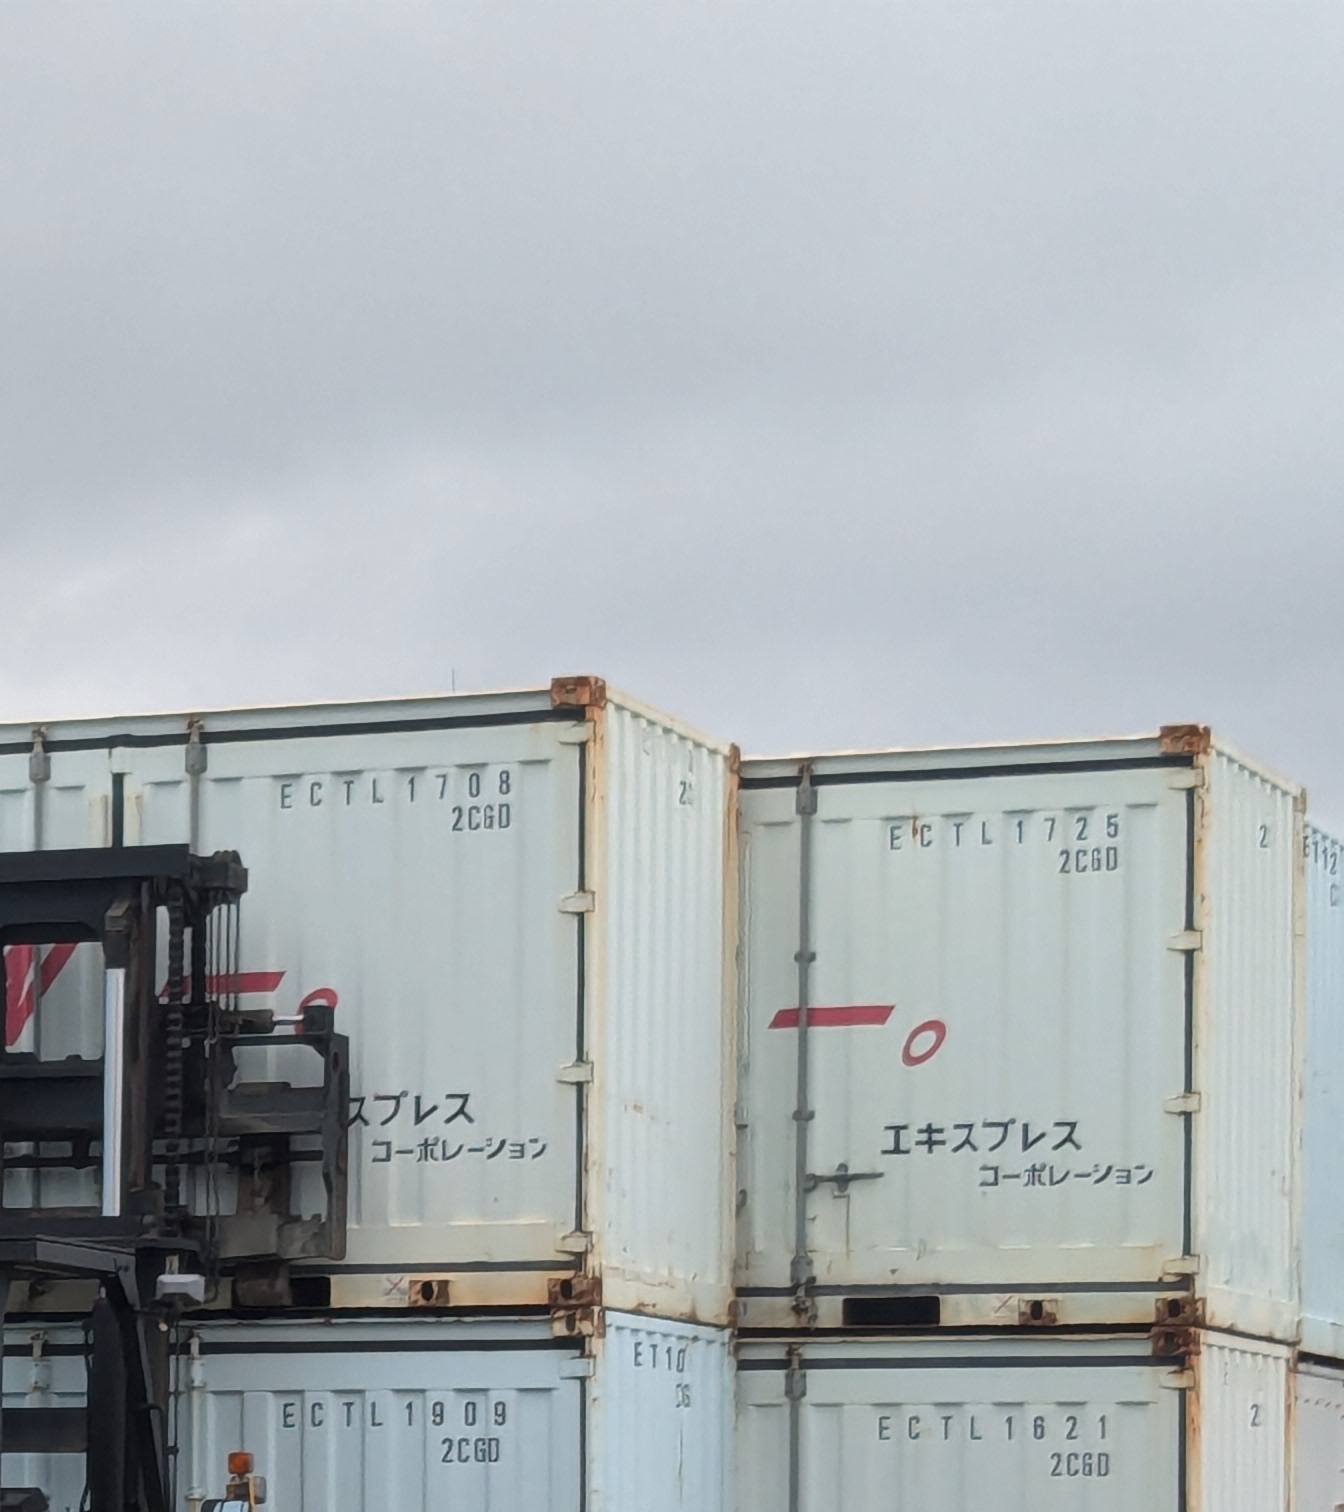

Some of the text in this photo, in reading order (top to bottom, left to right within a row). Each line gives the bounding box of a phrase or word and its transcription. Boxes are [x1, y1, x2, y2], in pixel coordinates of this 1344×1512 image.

[280, 769, 511, 809] ECTL1708
[889, 813, 1119, 850] ECTL1725
[348, 1089, 475, 1127] スプレス
[371, 1136, 548, 1163] コーポレーション
[880, 1118, 1082, 1155] エキスプレス
[979, 1163, 1154, 1188] コーポレーション
[282, 1401, 507, 1428] ECTL1909
[878, 1415, 1107, 1441] ECTL1621
[441, 1437, 500, 1463] 2CGD
